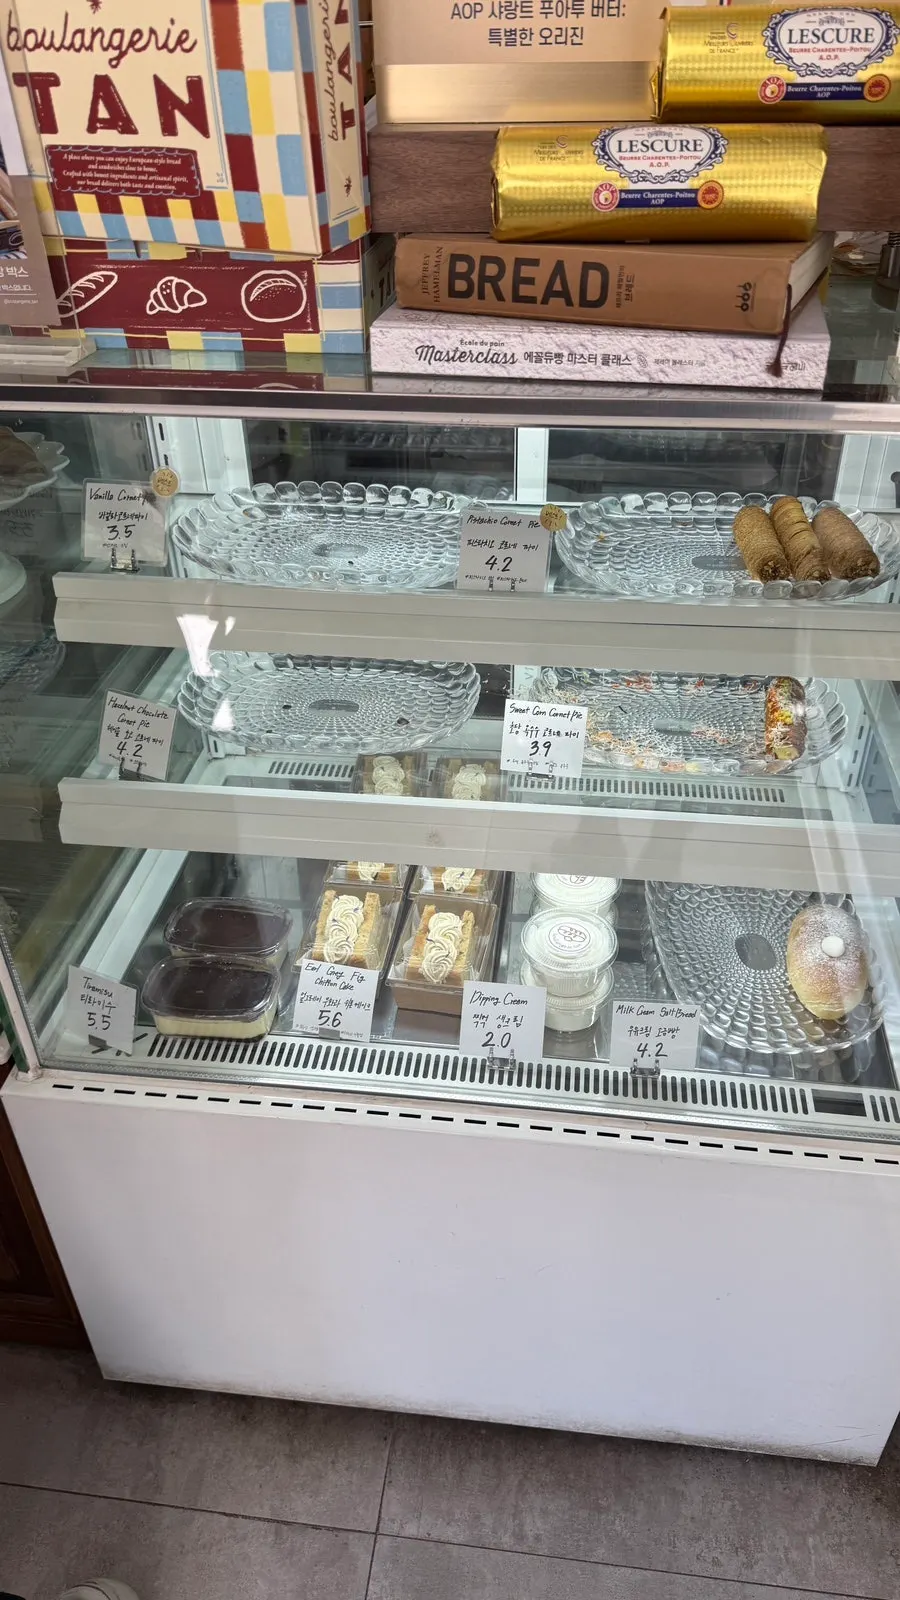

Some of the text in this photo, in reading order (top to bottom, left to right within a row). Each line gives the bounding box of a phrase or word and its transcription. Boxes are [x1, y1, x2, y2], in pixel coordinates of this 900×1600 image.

[450, 0, 627, 20] AOP 샤랑트 푸아투 버터:
[6, 10, 198, 69] boulangerie
[488, 26, 584, 47] 특별한 오리진
[787, 28, 875, 44] LESCURE
[12, 72, 210, 138] TAN
[617, 139, 703, 153] LESCURE
[166, 157, 181, 165] bread
[6, 266, 29, 278] 박스
[421, 253, 431, 295] JEFFREY
[448, 253, 610, 308] BREAD
[415, 345, 518, 366] Masterclass
[523, 351, 564, 365] 에꼴듀빵
[567, 352, 597, 366] 마스터
[600, 353, 632, 367] 클래스
[89, 488, 114, 500] Vanilla
[118, 489, 142, 502] Cornet
[467, 514, 541, 529] Pistachio Cornet Pie
[107, 524, 136, 541] 3.5
[467, 538, 495, 549] 피스타치오
[522, 543, 539, 552] 파이
[485, 555, 513, 573] 4.2
[137, 704, 169, 720] Chocolate
[509, 702, 530, 715] Sweet
[532, 705, 547, 716] Corn
[549, 707, 571, 719] Cornet
[509, 721, 522, 735] 초당
[523, 724, 541, 738] 옥수수
[565, 731, 580, 739] 파이
[116, 741, 144, 758] 4.2
[151, 737, 164, 747] 파이
[326, 965, 345, 980] Grey
[350, 971, 366, 983] Fig
[314, 976, 355, 991] Chiffon Cake
[80, 993, 117, 1015] 티라미수
[469, 989, 528, 1007] Dipping Cream
[616, 1004, 635, 1015] Milk
[636, 1005, 655, 1016] Cream
[87, 1012, 112, 1031] 5.5
[318, 1010, 343, 1028] 5.6
[472, 1013, 489, 1028] 찍먹
[481, 1031, 512, 1049] 2.0
[628, 1025, 681, 1039] 우유크림 소금빵
[637, 1042, 668, 1058] 4.2
